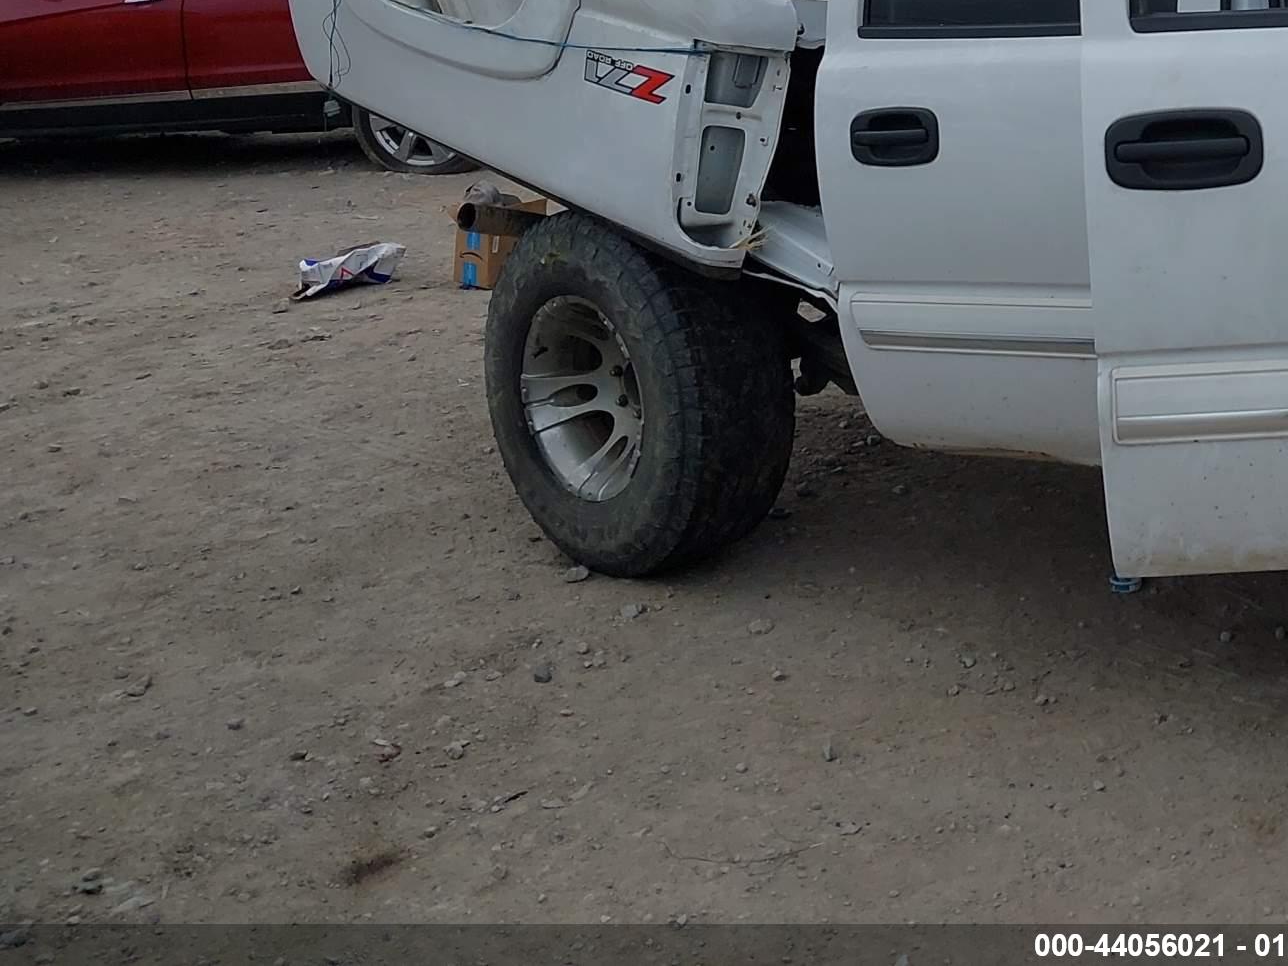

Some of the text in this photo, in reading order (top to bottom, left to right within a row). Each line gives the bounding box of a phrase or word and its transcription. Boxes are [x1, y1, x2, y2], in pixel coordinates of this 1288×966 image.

[587, 50, 634, 71] OFF ROAD
[584, 56, 676, 105] Z71
